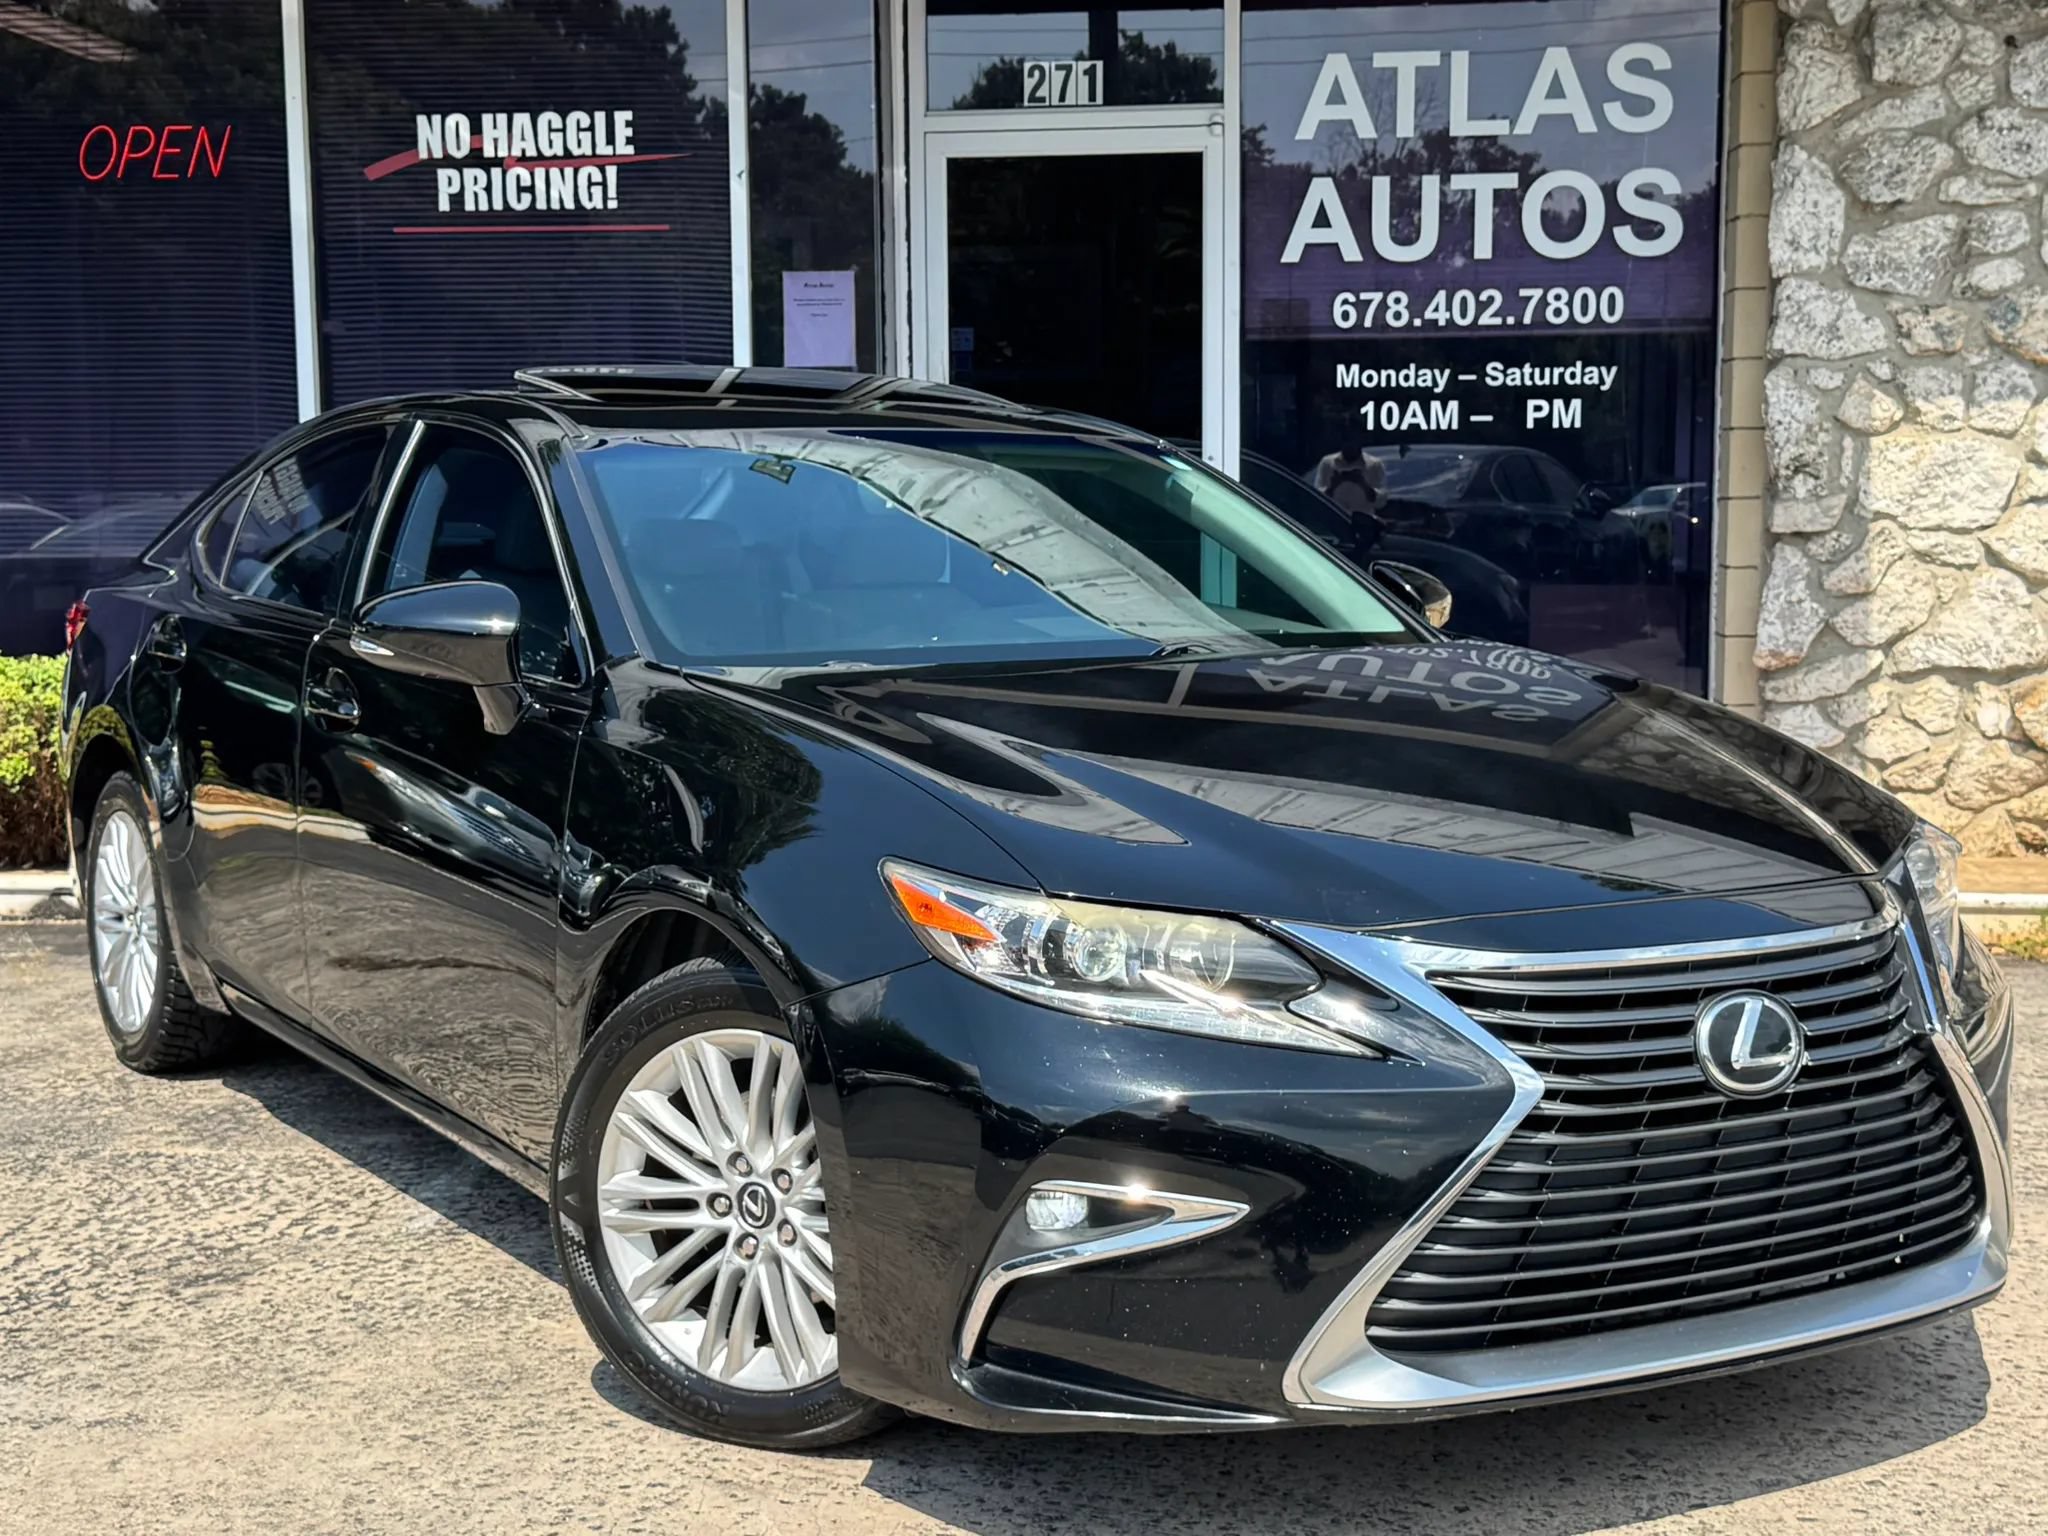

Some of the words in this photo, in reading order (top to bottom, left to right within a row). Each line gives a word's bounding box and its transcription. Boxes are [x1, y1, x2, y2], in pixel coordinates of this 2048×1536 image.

[1027, 63, 1097, 104] 271
[1294, 42, 1674, 140] ATLAS
[79, 124, 233, 181] OPEN
[416, 113, 471, 159] NO
[481, 110, 635, 158] HAGGLE
[436, 165, 619, 212] PRICING!
[1280, 167, 1684, 263] AUTOS
[1332, 286, 1625, 328] 678.402.7800
[1336, 363, 1450, 393] Monday
[1484, 361, 1618, 391] Saturday
[1360, 400, 1459, 431] 10AM
[1526, 398, 1582, 429] PM
